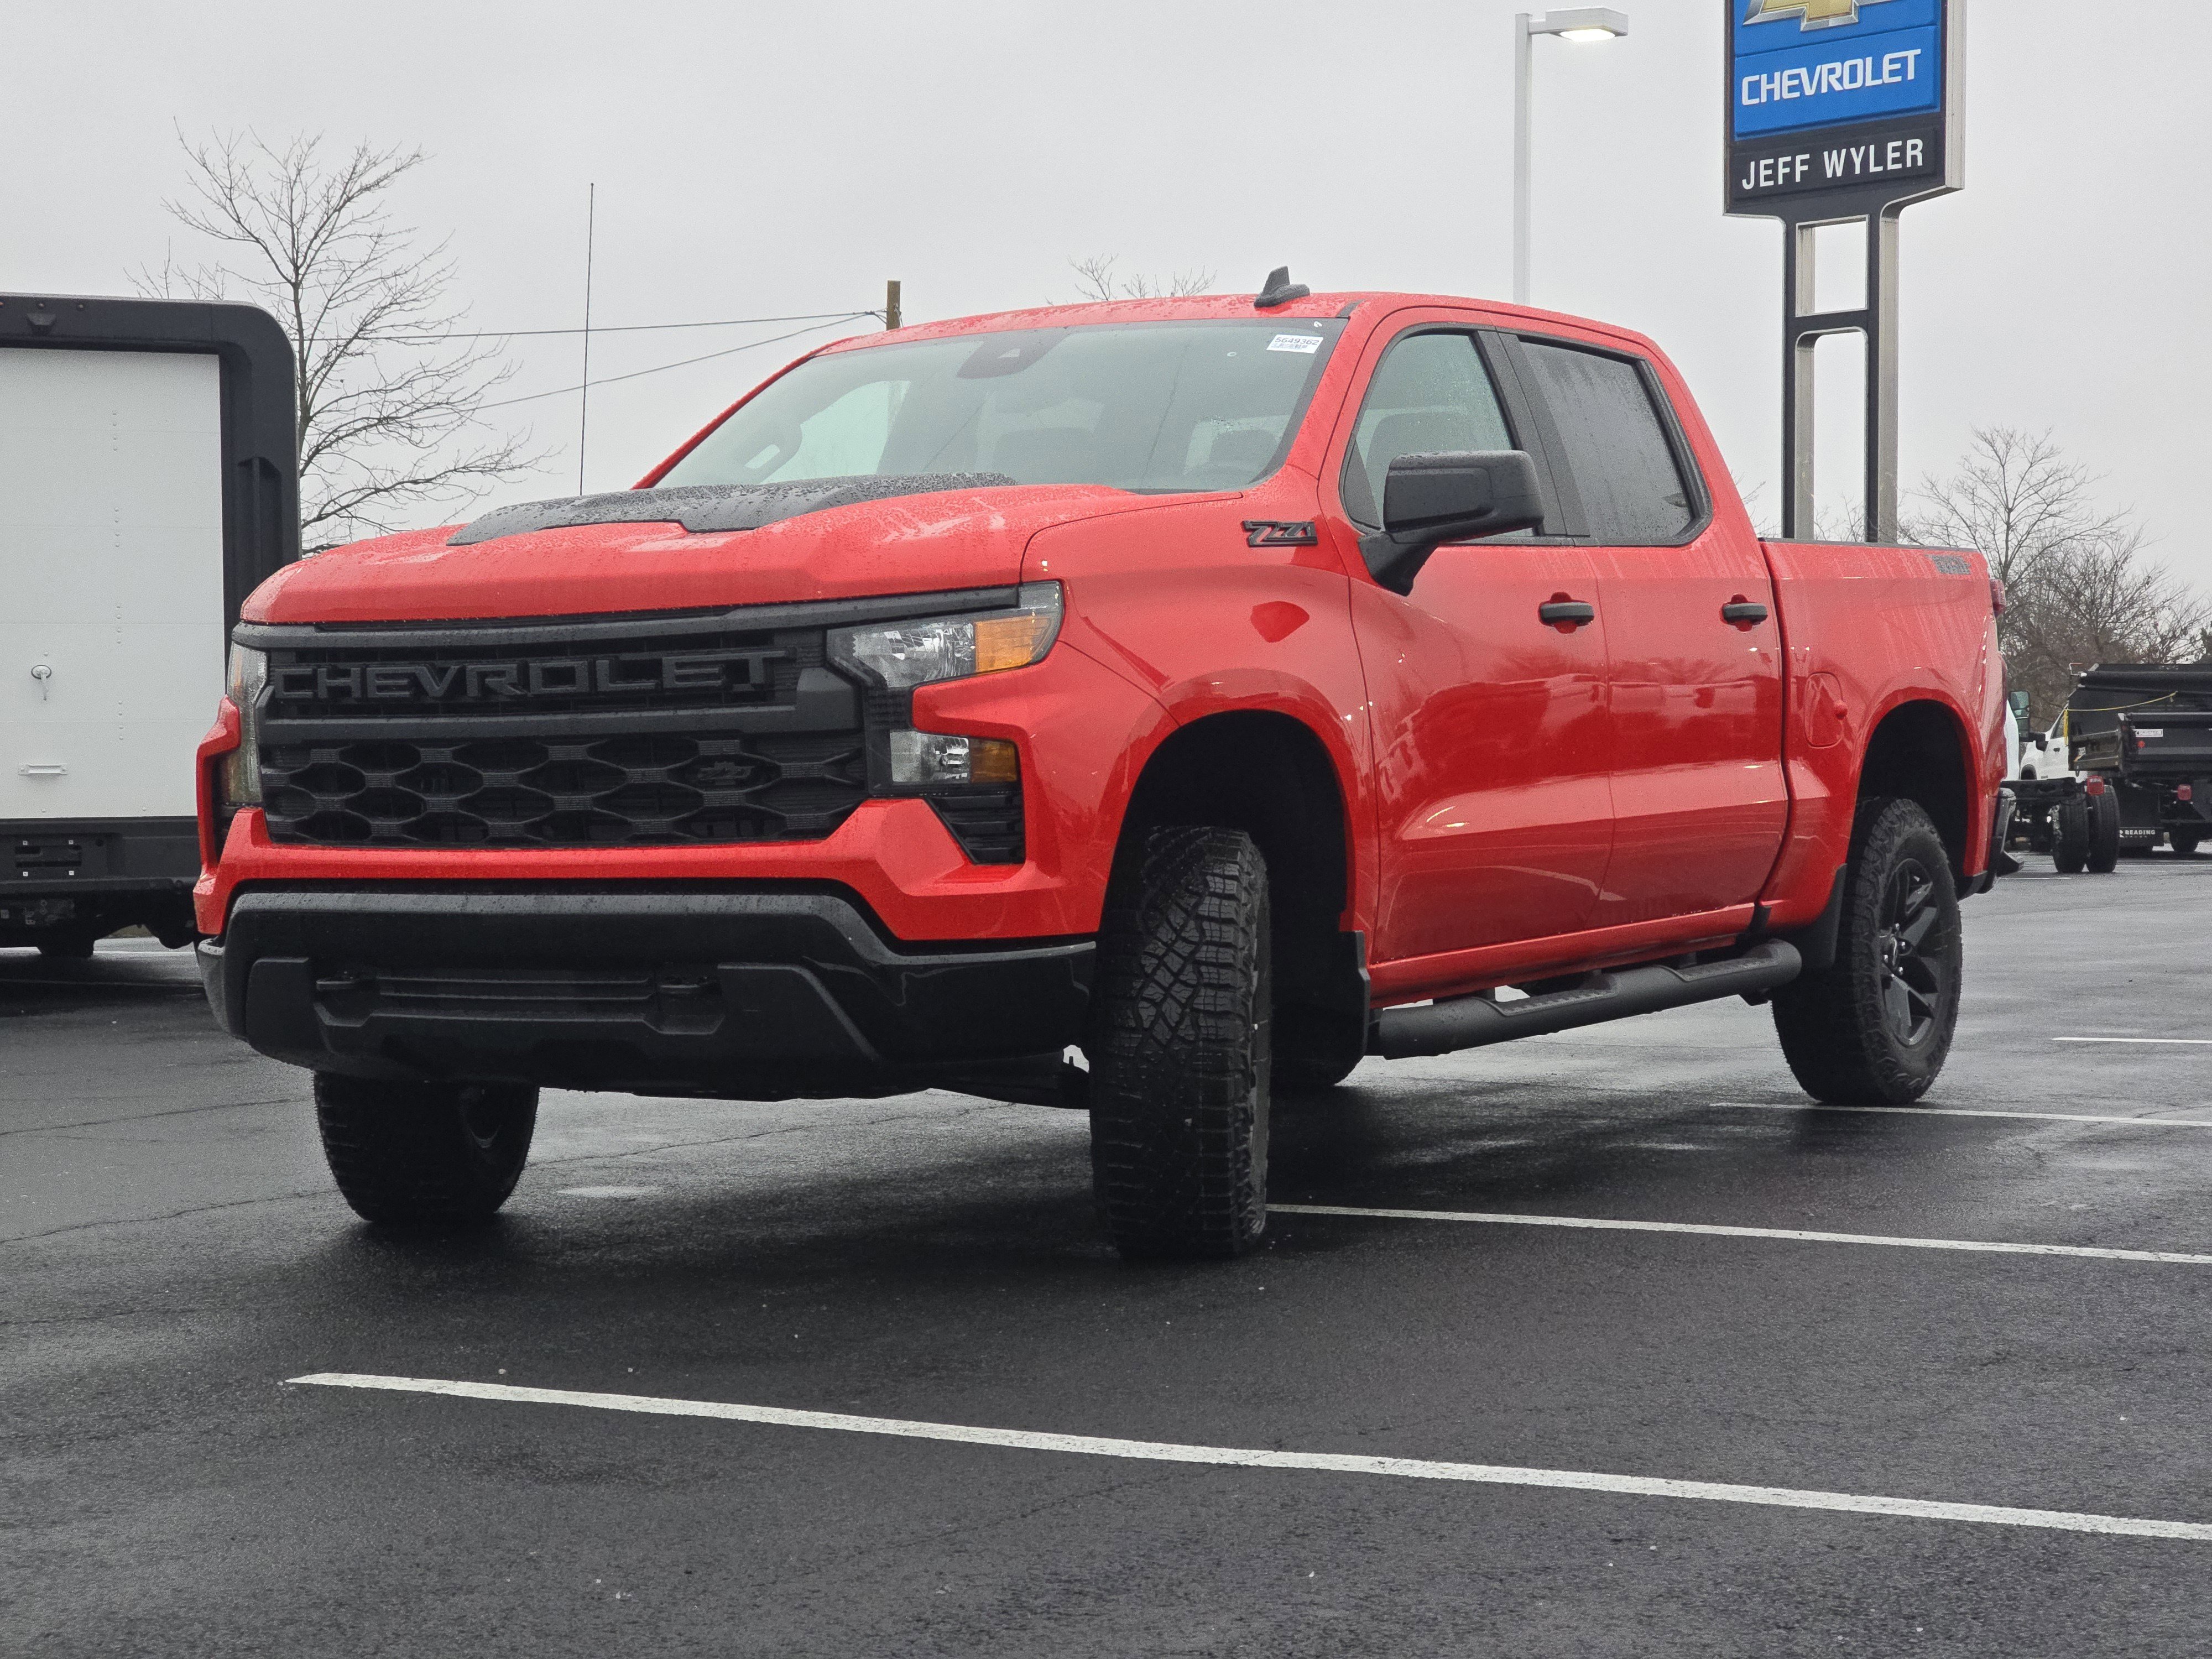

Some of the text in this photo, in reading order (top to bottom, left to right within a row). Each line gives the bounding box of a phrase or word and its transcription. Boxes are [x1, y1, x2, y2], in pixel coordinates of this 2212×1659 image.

[1741, 49, 1922, 105] CHEVROLET
[1741, 138, 1923, 190] JEFF WYLER
[1275, 337, 1319, 345] 5649362
[274, 650, 788, 699] CHEVROLET
